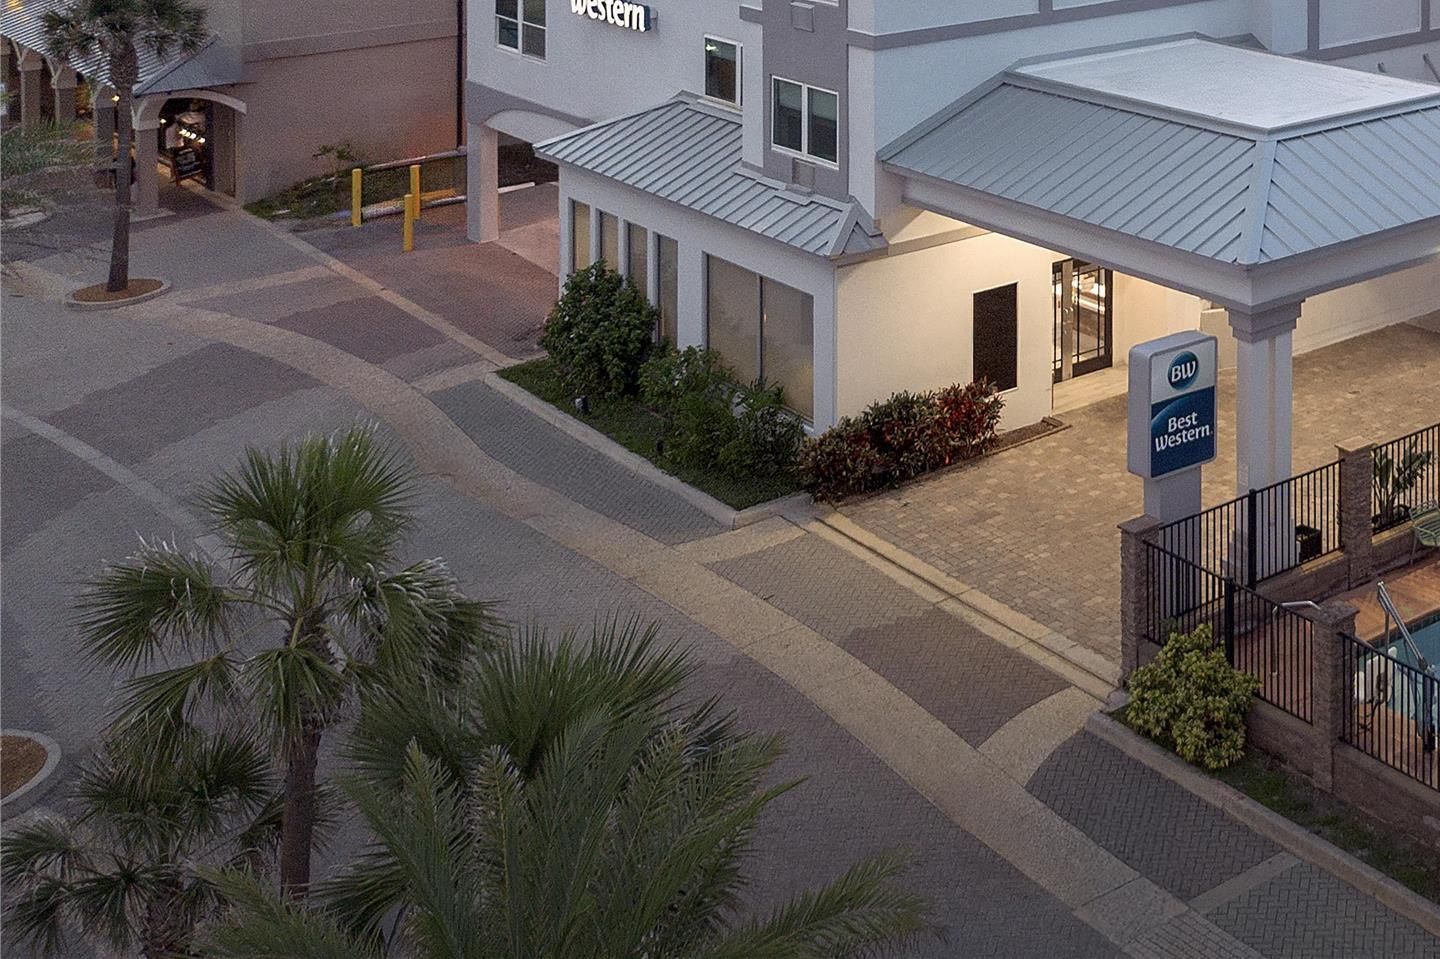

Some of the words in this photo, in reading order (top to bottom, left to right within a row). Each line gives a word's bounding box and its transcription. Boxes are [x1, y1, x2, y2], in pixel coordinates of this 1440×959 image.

[1171, 360, 1197, 383] BW
[1168, 411, 1198, 433] Best
[1155, 424, 1210, 452] Western
